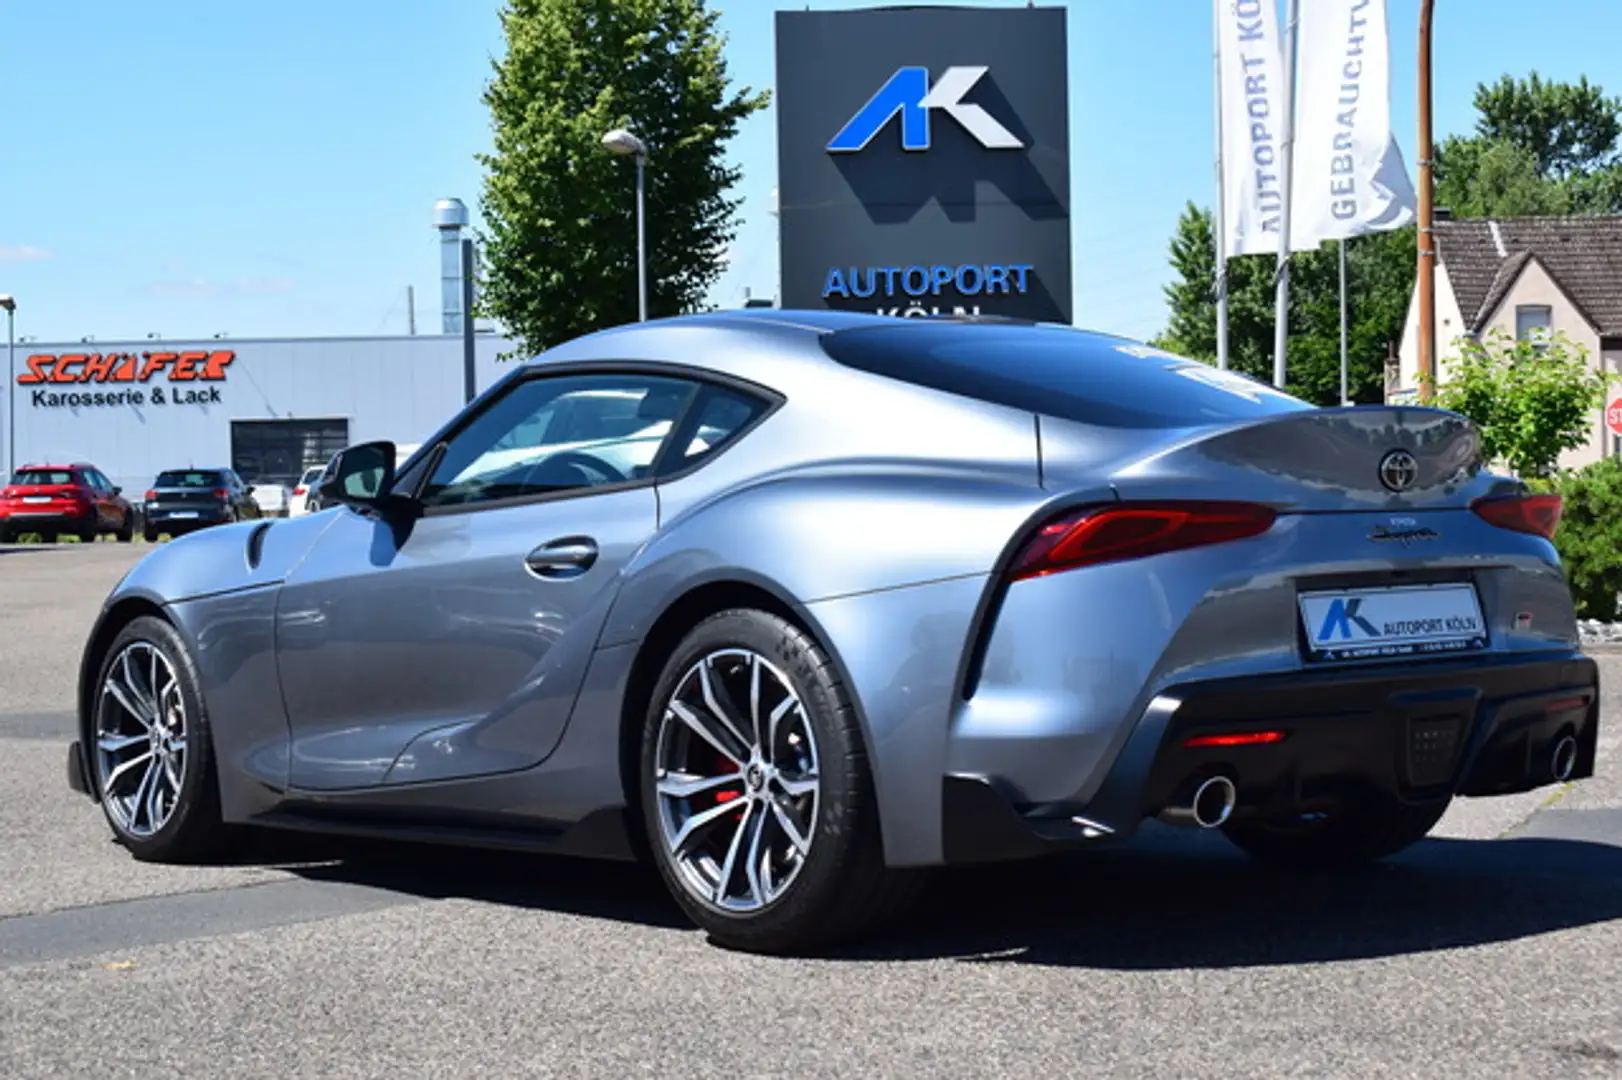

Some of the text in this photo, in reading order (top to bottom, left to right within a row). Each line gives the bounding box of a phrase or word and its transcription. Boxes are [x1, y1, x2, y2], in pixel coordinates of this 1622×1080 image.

[825, 66, 1025, 150] AK
[1241, 53, 1281, 232] AUTOPORT
[822, 264, 1034, 297] AUTOPORT
[32, 386, 222, 407] Karosserie & Lack
[1383, 618, 1443, 636] AUTOPORT
